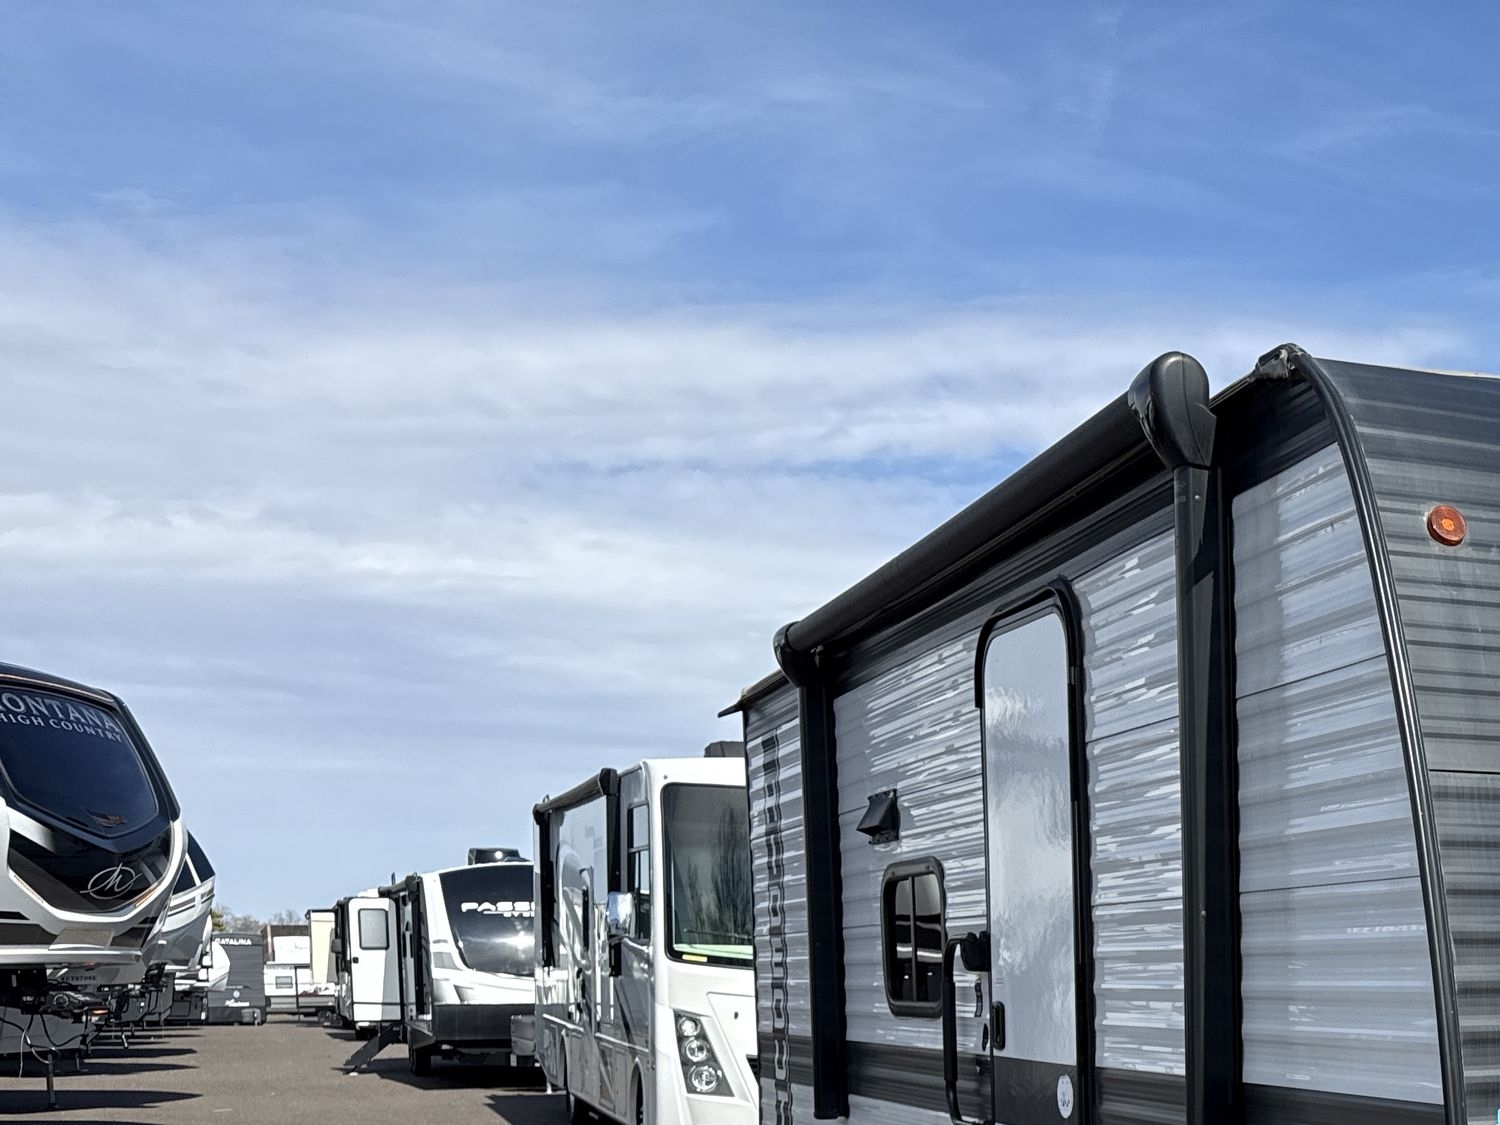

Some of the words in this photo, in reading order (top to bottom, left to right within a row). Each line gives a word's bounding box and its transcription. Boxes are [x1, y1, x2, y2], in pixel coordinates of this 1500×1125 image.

[0, 693, 120, 731] ONTANA
[49, 719, 122, 741] COUNTRY
[461, 901, 535, 912] PASS
